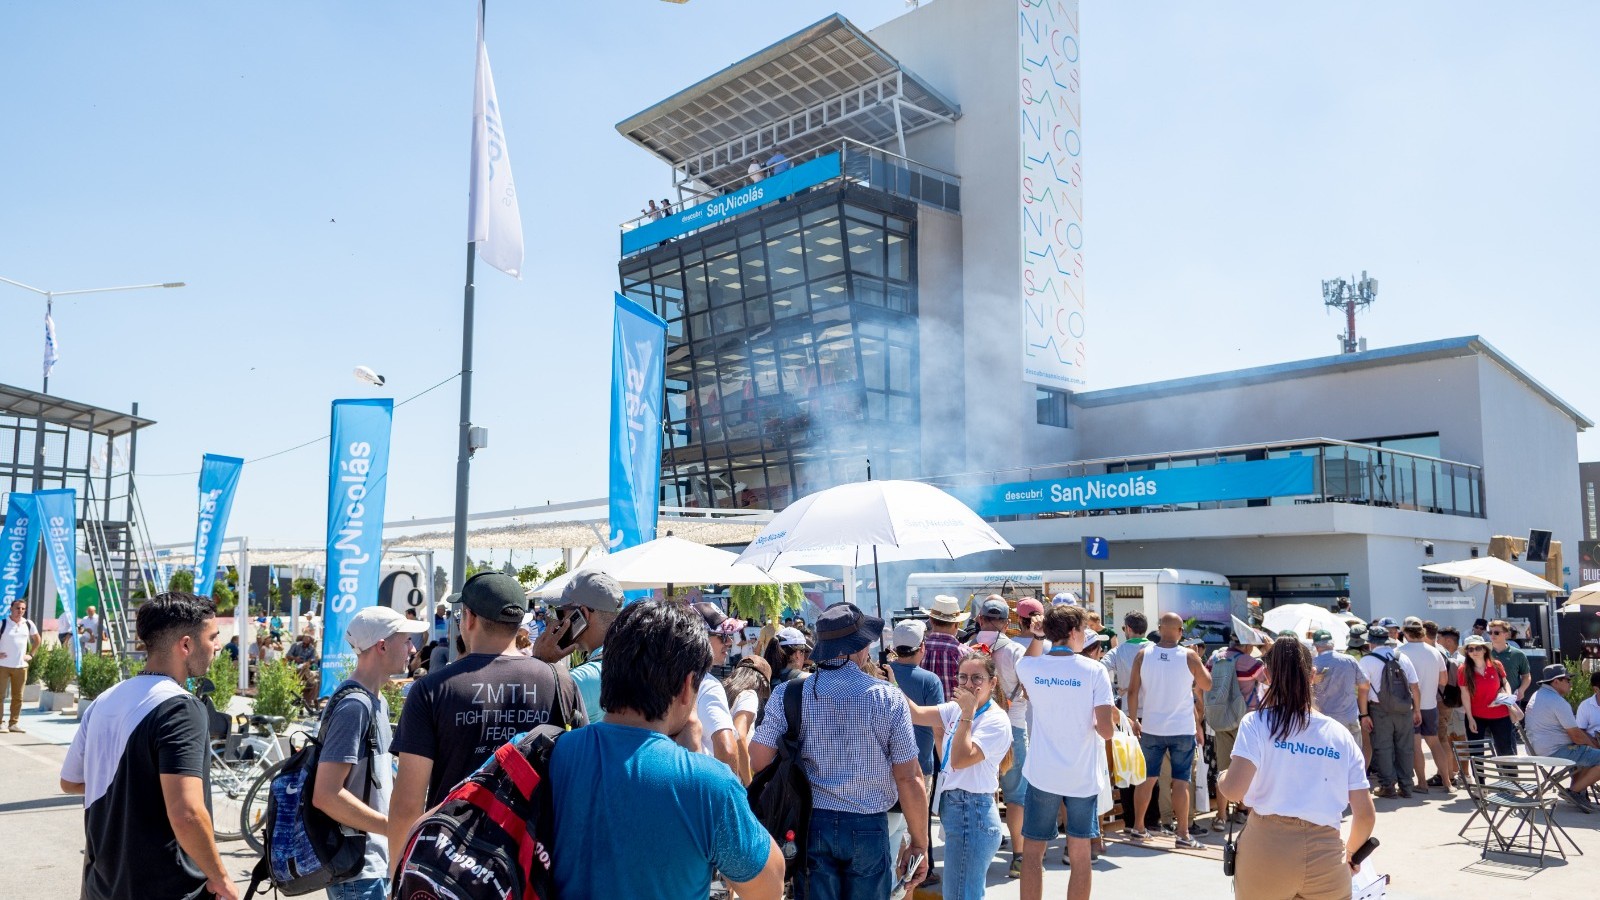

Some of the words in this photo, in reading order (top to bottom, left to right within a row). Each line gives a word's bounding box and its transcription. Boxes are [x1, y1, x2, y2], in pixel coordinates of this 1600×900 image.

[1005, 488, 1043, 502] descubrí
[471, 683, 537, 704] ZMTH
[455, 710, 490, 726] FIGHT
[492, 710, 516, 723] THE
[517, 709, 550, 724] DEAD
[485, 726, 517, 741] FEAR
